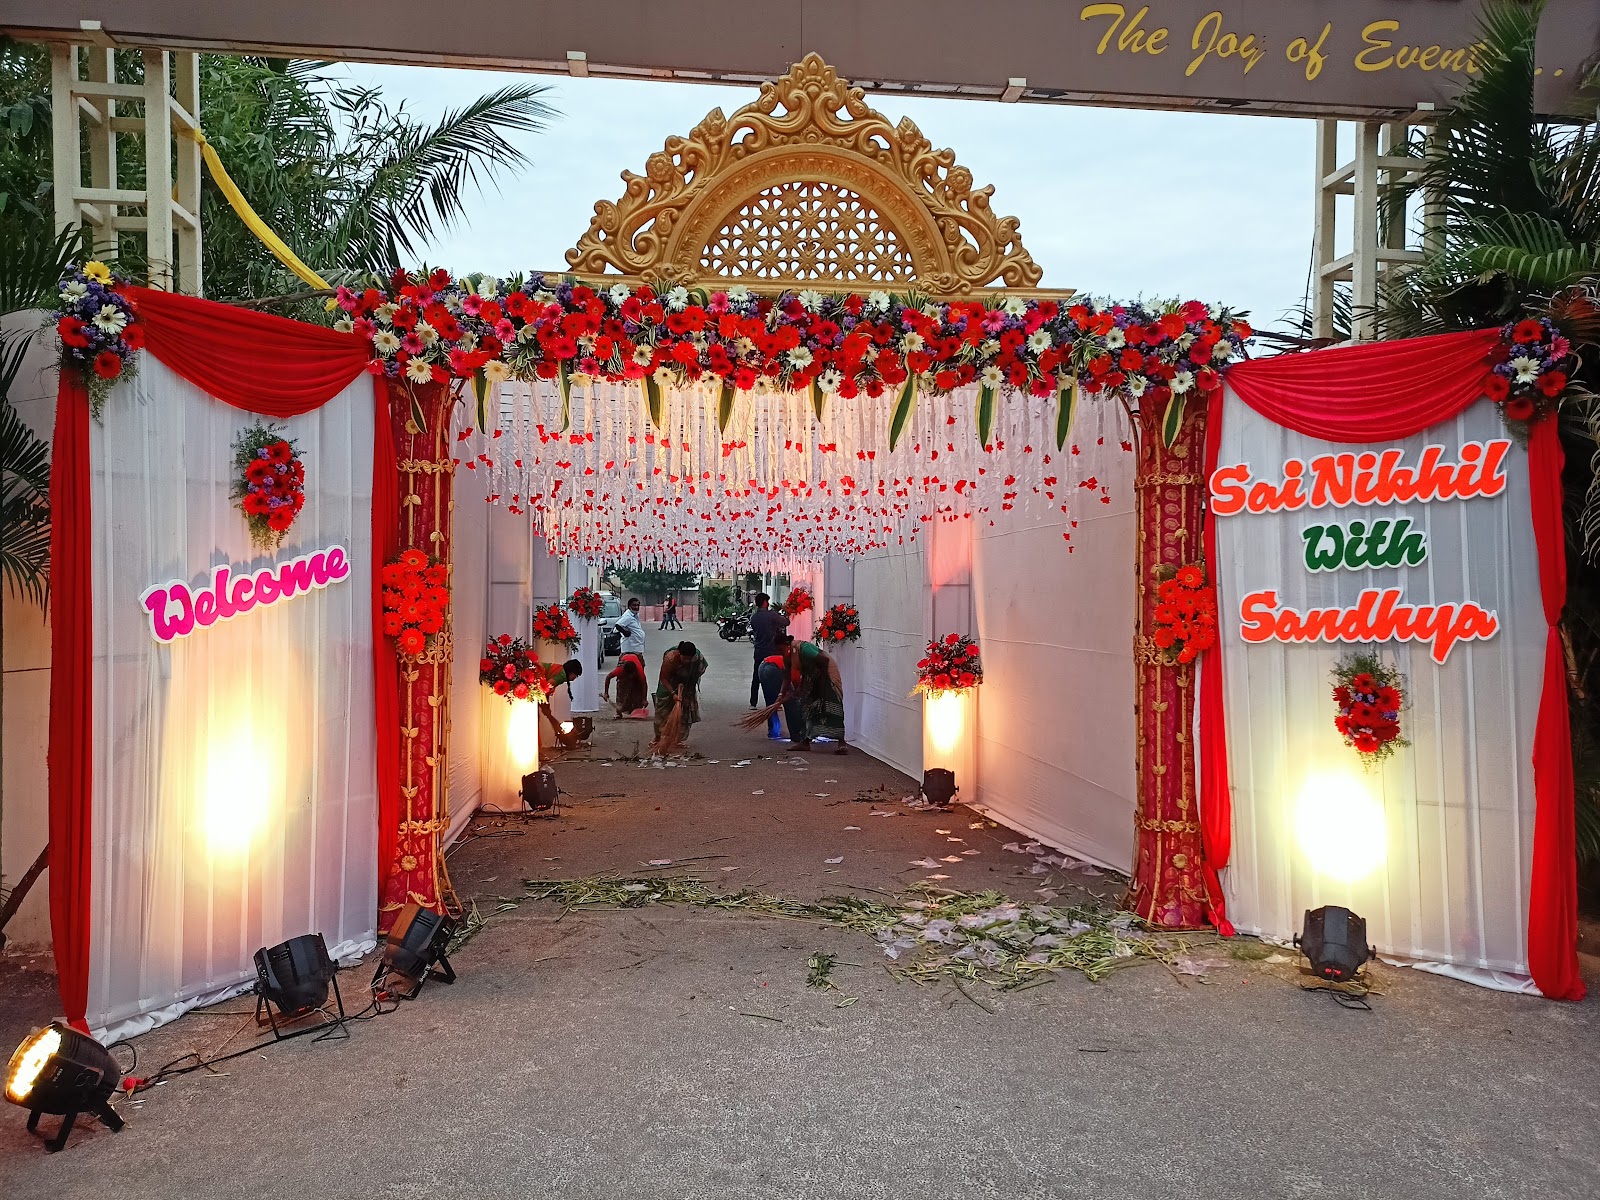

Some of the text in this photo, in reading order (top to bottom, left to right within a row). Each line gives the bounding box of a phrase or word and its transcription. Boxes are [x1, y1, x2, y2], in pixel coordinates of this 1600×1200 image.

[1080, 3, 1169, 55] The
[1185, 11, 1266, 77] Joy
[1286, 21, 1331, 81] of
[1210, 440, 1512, 515] Sai Nikhil
[1302, 518, 1427, 572] With
[143, 547, 350, 642] Welcome
[1240, 588, 1498, 664] Sandhya
